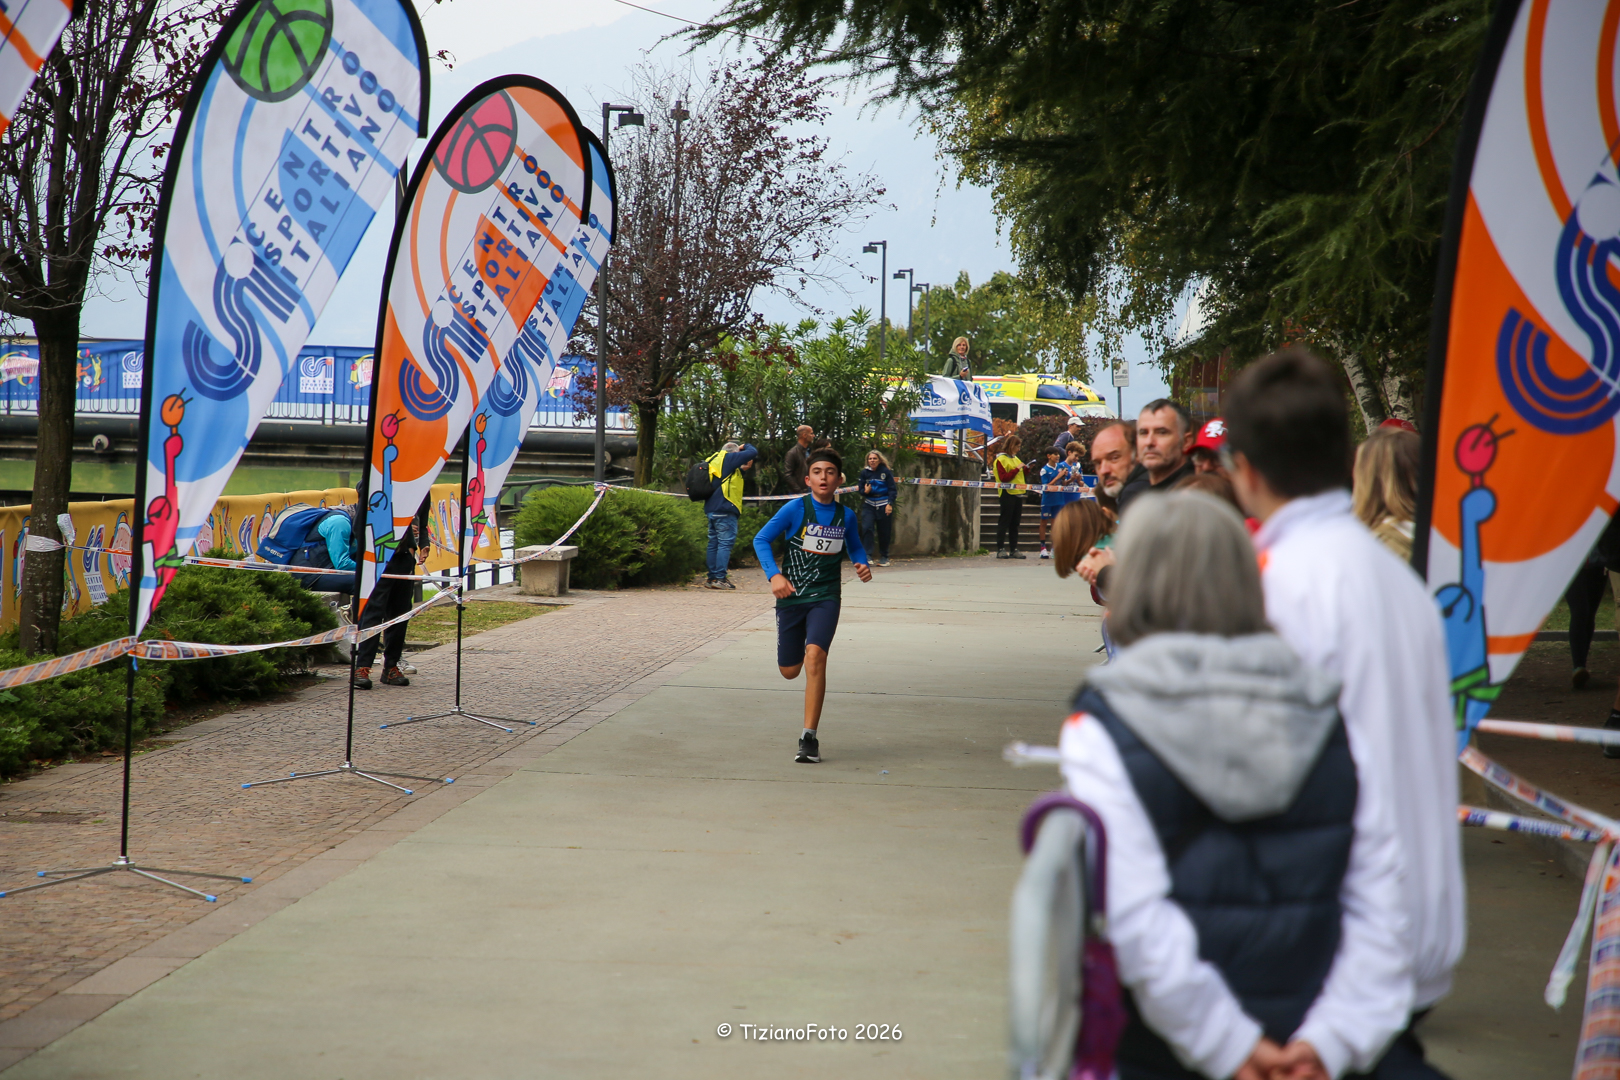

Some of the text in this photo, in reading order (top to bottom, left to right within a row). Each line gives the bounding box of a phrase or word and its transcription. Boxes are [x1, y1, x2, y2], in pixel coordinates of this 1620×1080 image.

[245, 51, 361, 248] CENTRO
[263, 70, 378, 267] SPORTIVO
[280, 88, 396, 285] ITALIANO
[447, 154, 539, 305] CENTRO
[460, 170, 551, 321] SPORTIVO
[474, 184, 565, 334] ITALIANO
[536, 213, 599, 343] ITALIANO
[815, 539, 832, 551] 87
